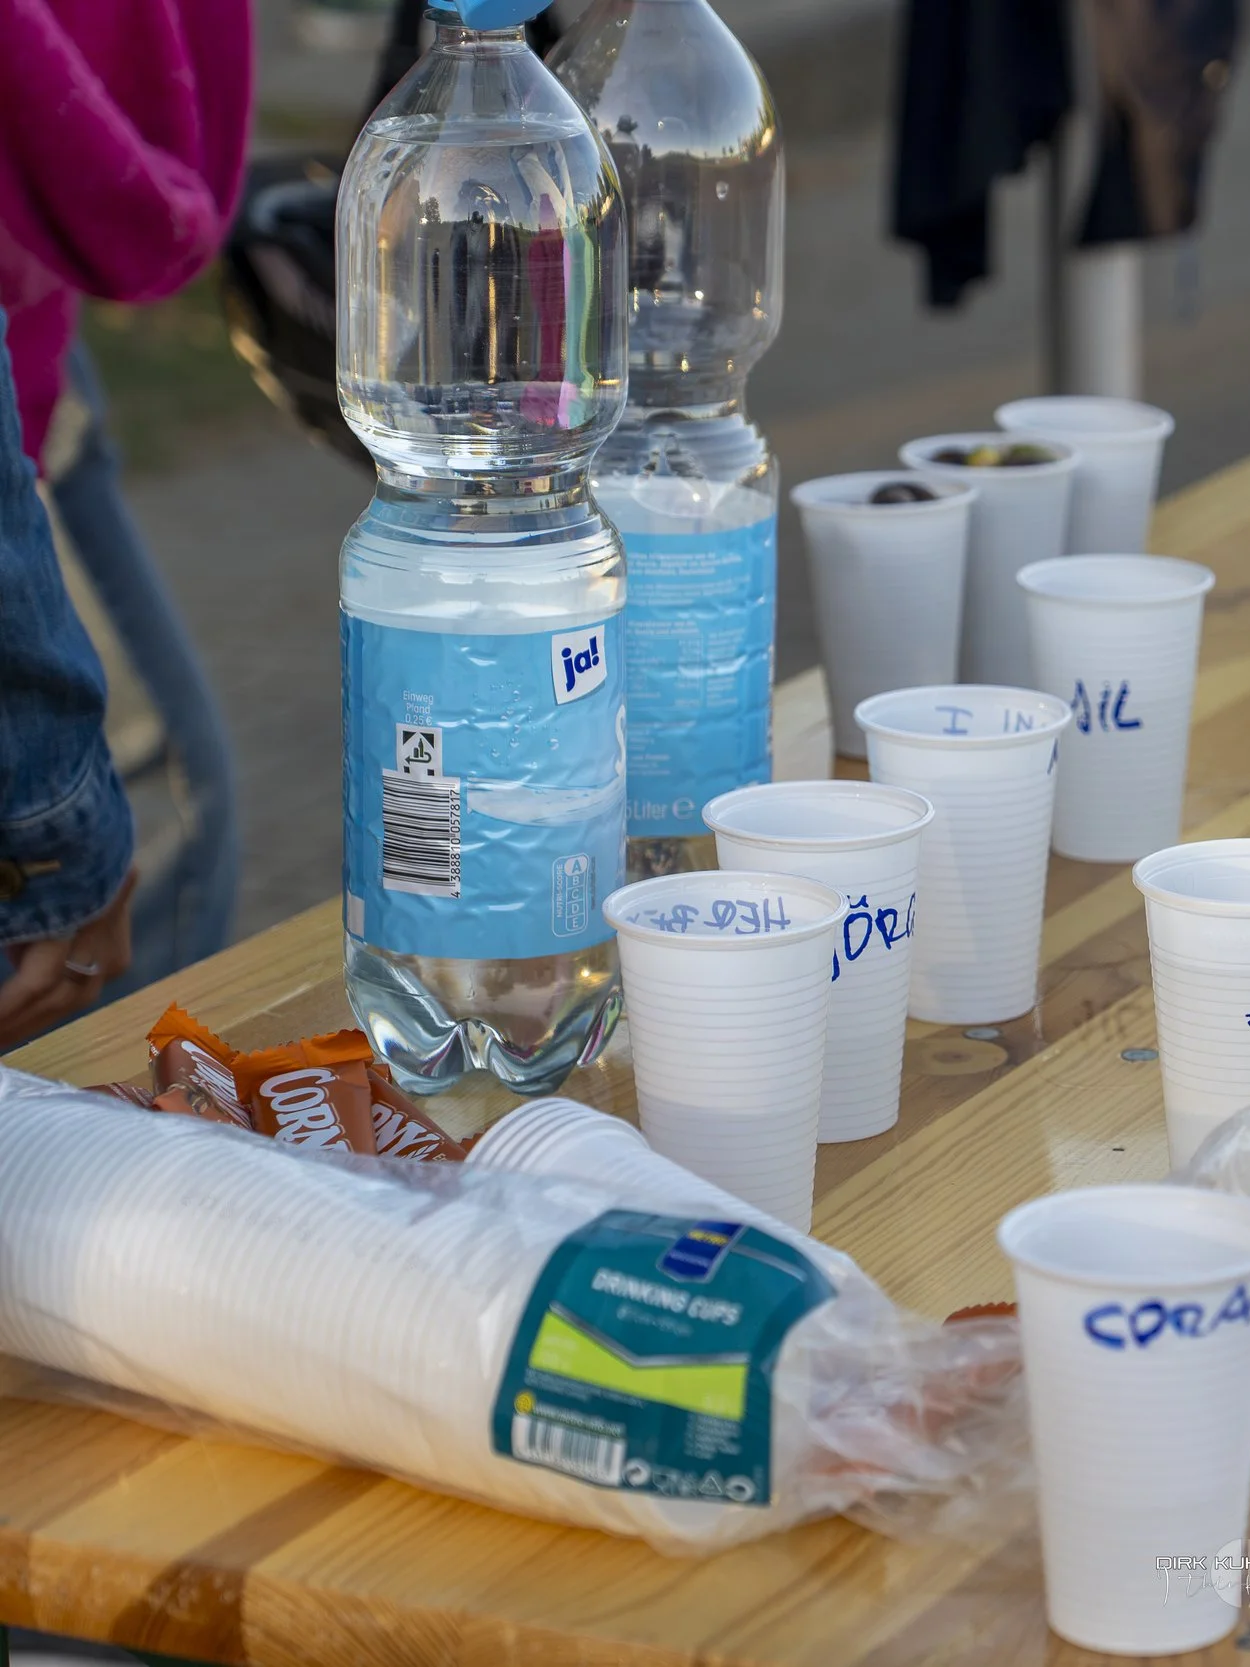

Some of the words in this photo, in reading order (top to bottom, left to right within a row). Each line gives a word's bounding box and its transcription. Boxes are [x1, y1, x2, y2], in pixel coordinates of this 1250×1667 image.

[561, 636, 600, 692] ja!
[402, 690, 434, 705] Einweg
[634, 798, 668, 820] Liter
[572, 860, 582, 873] A
[573, 875, 580, 885] B
[571, 889, 579, 899] C
[571, 903, 580, 914] D
[572, 917, 579, 928] E
[591, 1267, 690, 1314] DRINKING
[687, 1296, 743, 1327] CUPS
